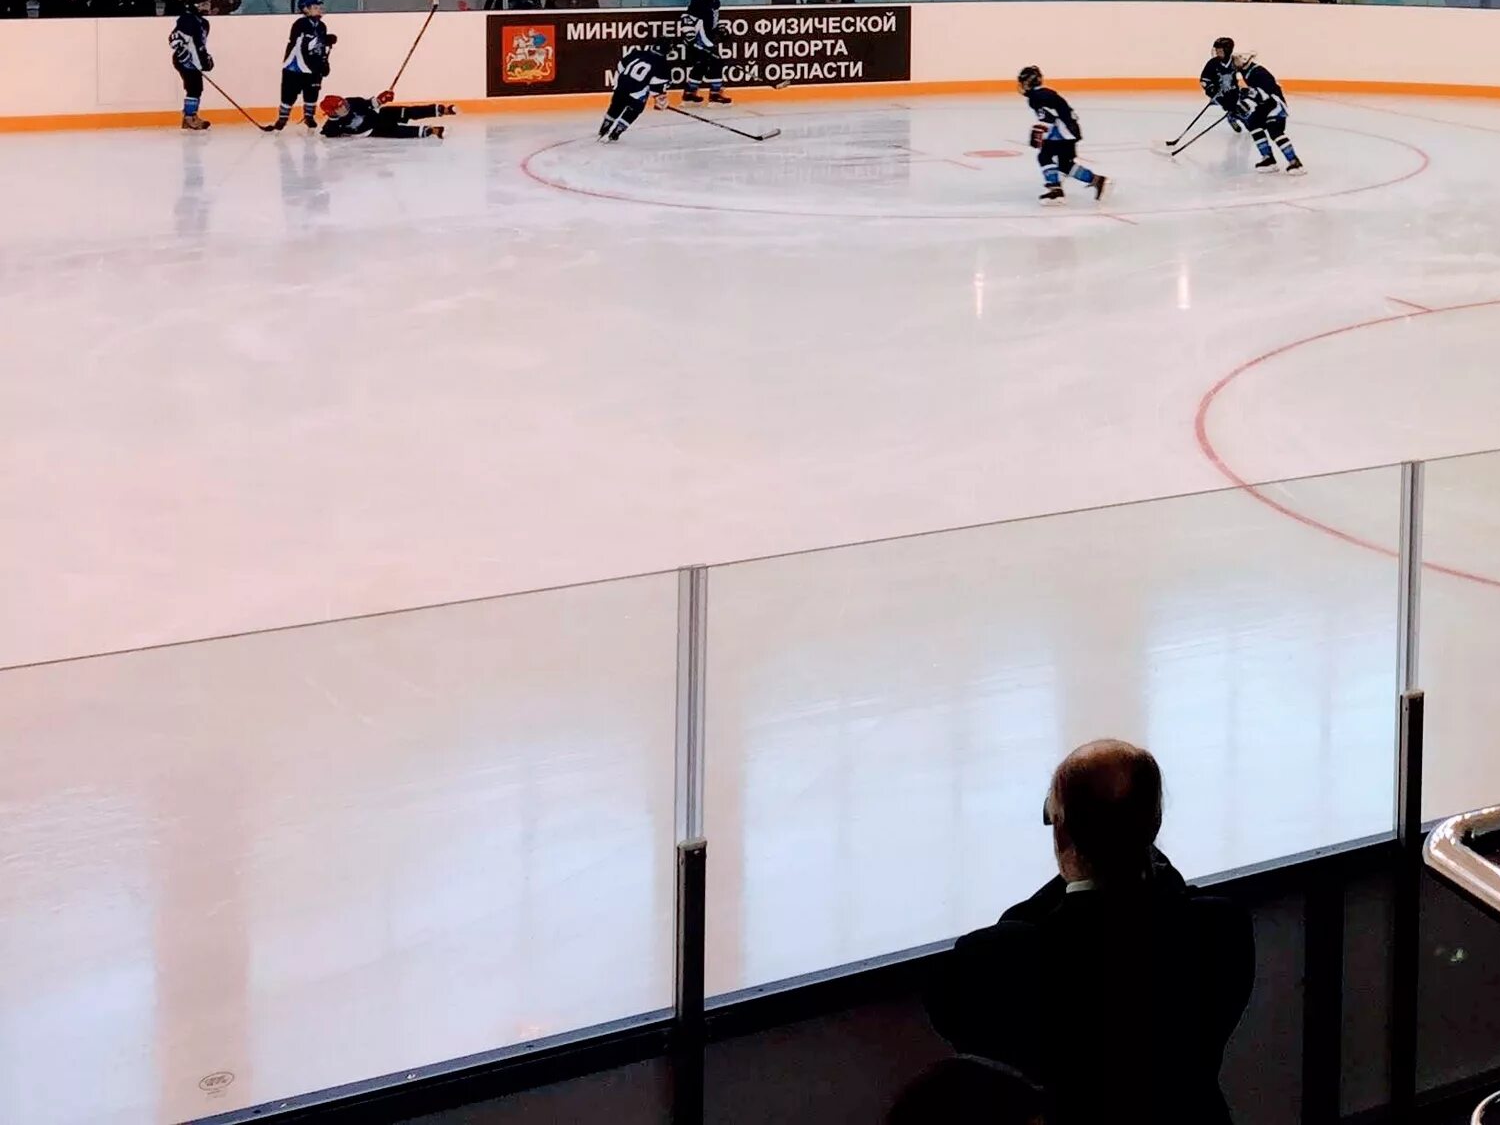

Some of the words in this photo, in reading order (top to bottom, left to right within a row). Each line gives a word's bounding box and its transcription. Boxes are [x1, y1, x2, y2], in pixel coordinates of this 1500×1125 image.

[566, 19, 748, 41] МИНИСТЕВО
[754, 12, 896, 36] ФИЗИЧЕСКОЙ
[744, 42, 758, 58] И
[765, 39, 848, 57] СПОРТА
[764, 61, 863, 80] ОБЛАСТИ
